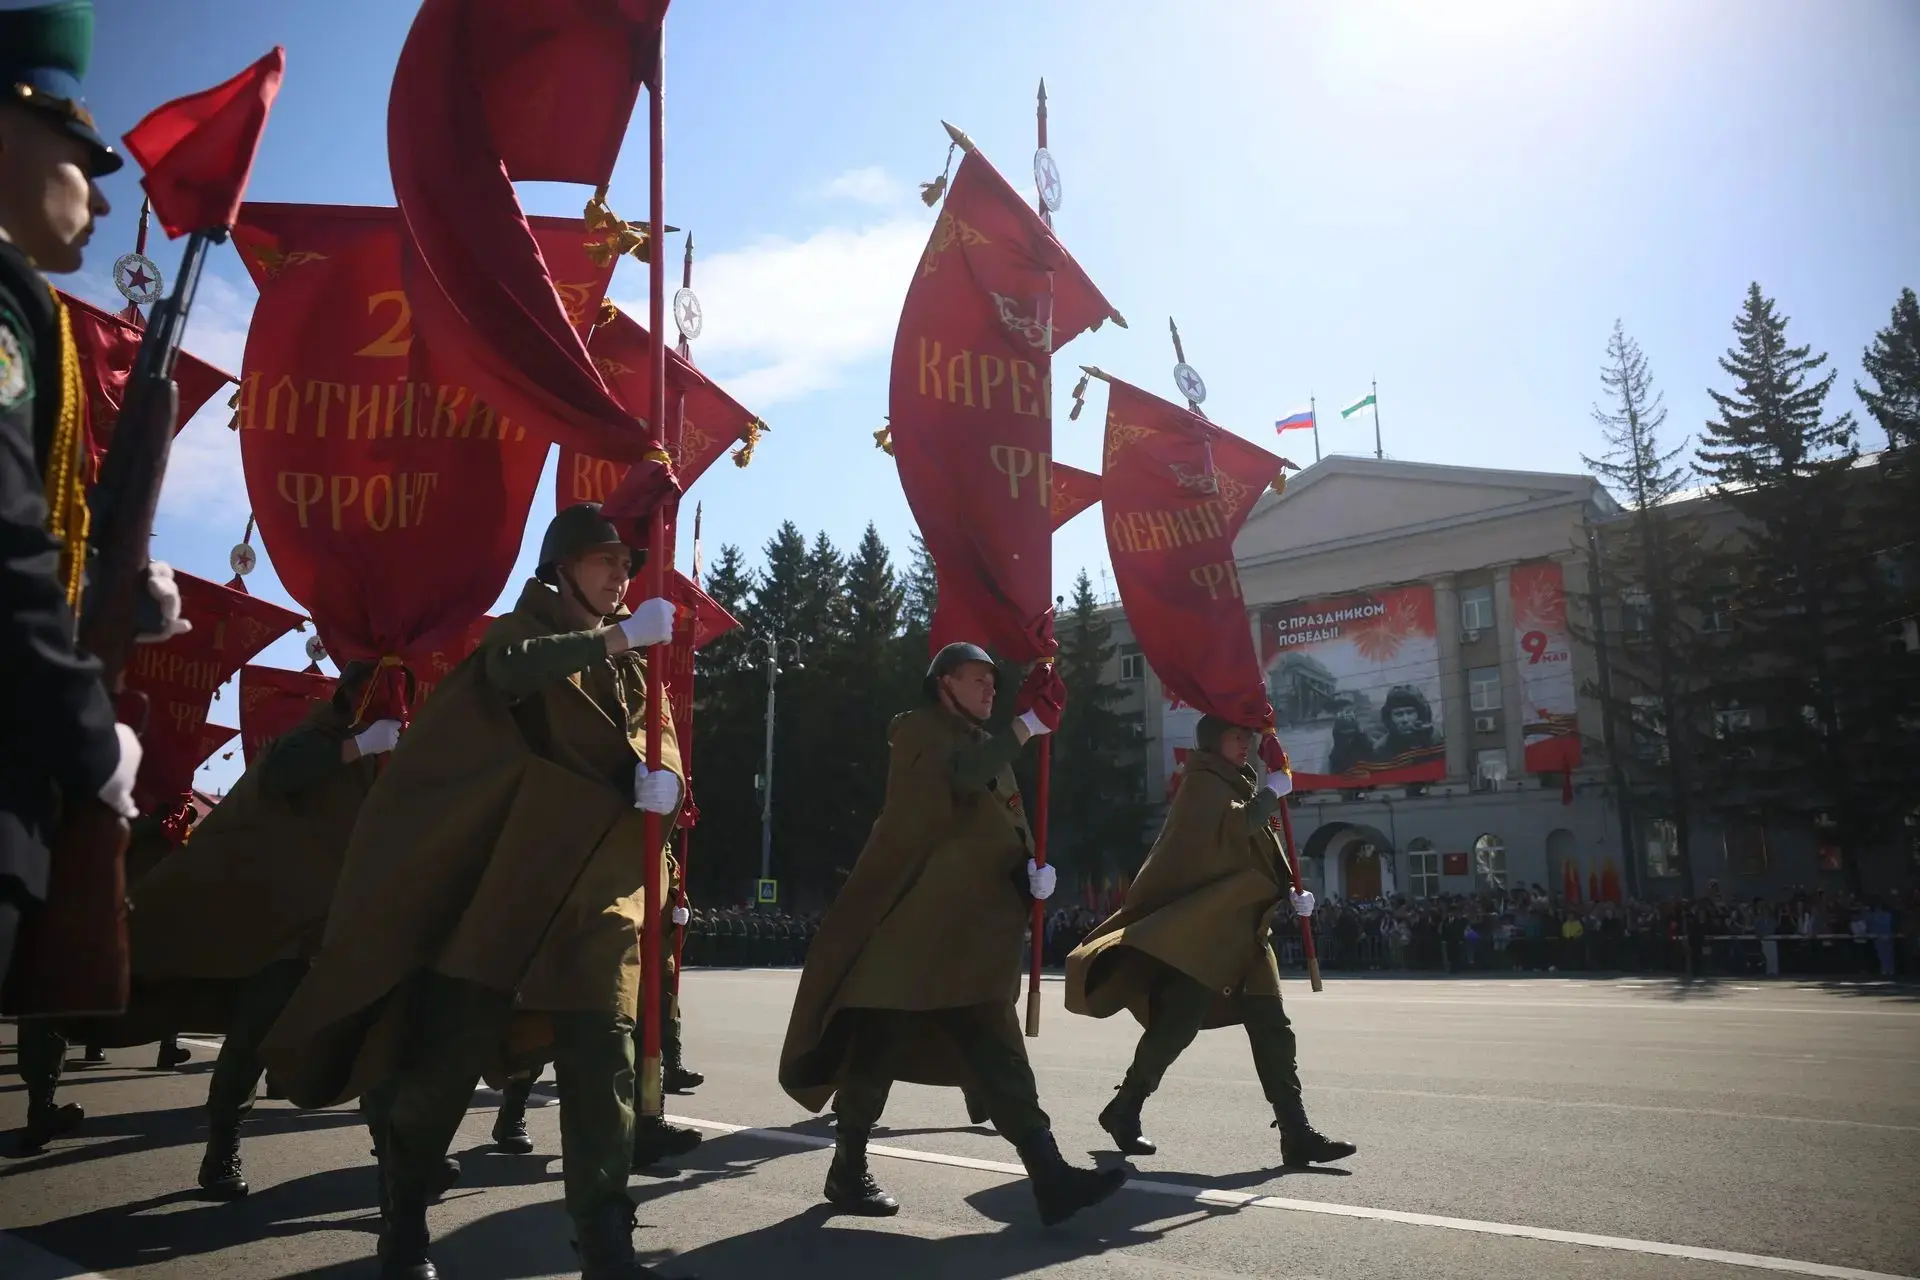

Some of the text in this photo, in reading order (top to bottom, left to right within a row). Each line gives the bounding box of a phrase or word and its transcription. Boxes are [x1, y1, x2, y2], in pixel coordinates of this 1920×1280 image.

[353, 290, 416, 357] 2
[277, 470, 439, 532] ФРОНТ
[1278, 603, 1385, 630] С ПРАЗДНИКОМ
[1279, 627, 1339, 646] ПОБЕДЫ!
[1521, 631, 1568, 665] 9 МАЯ
